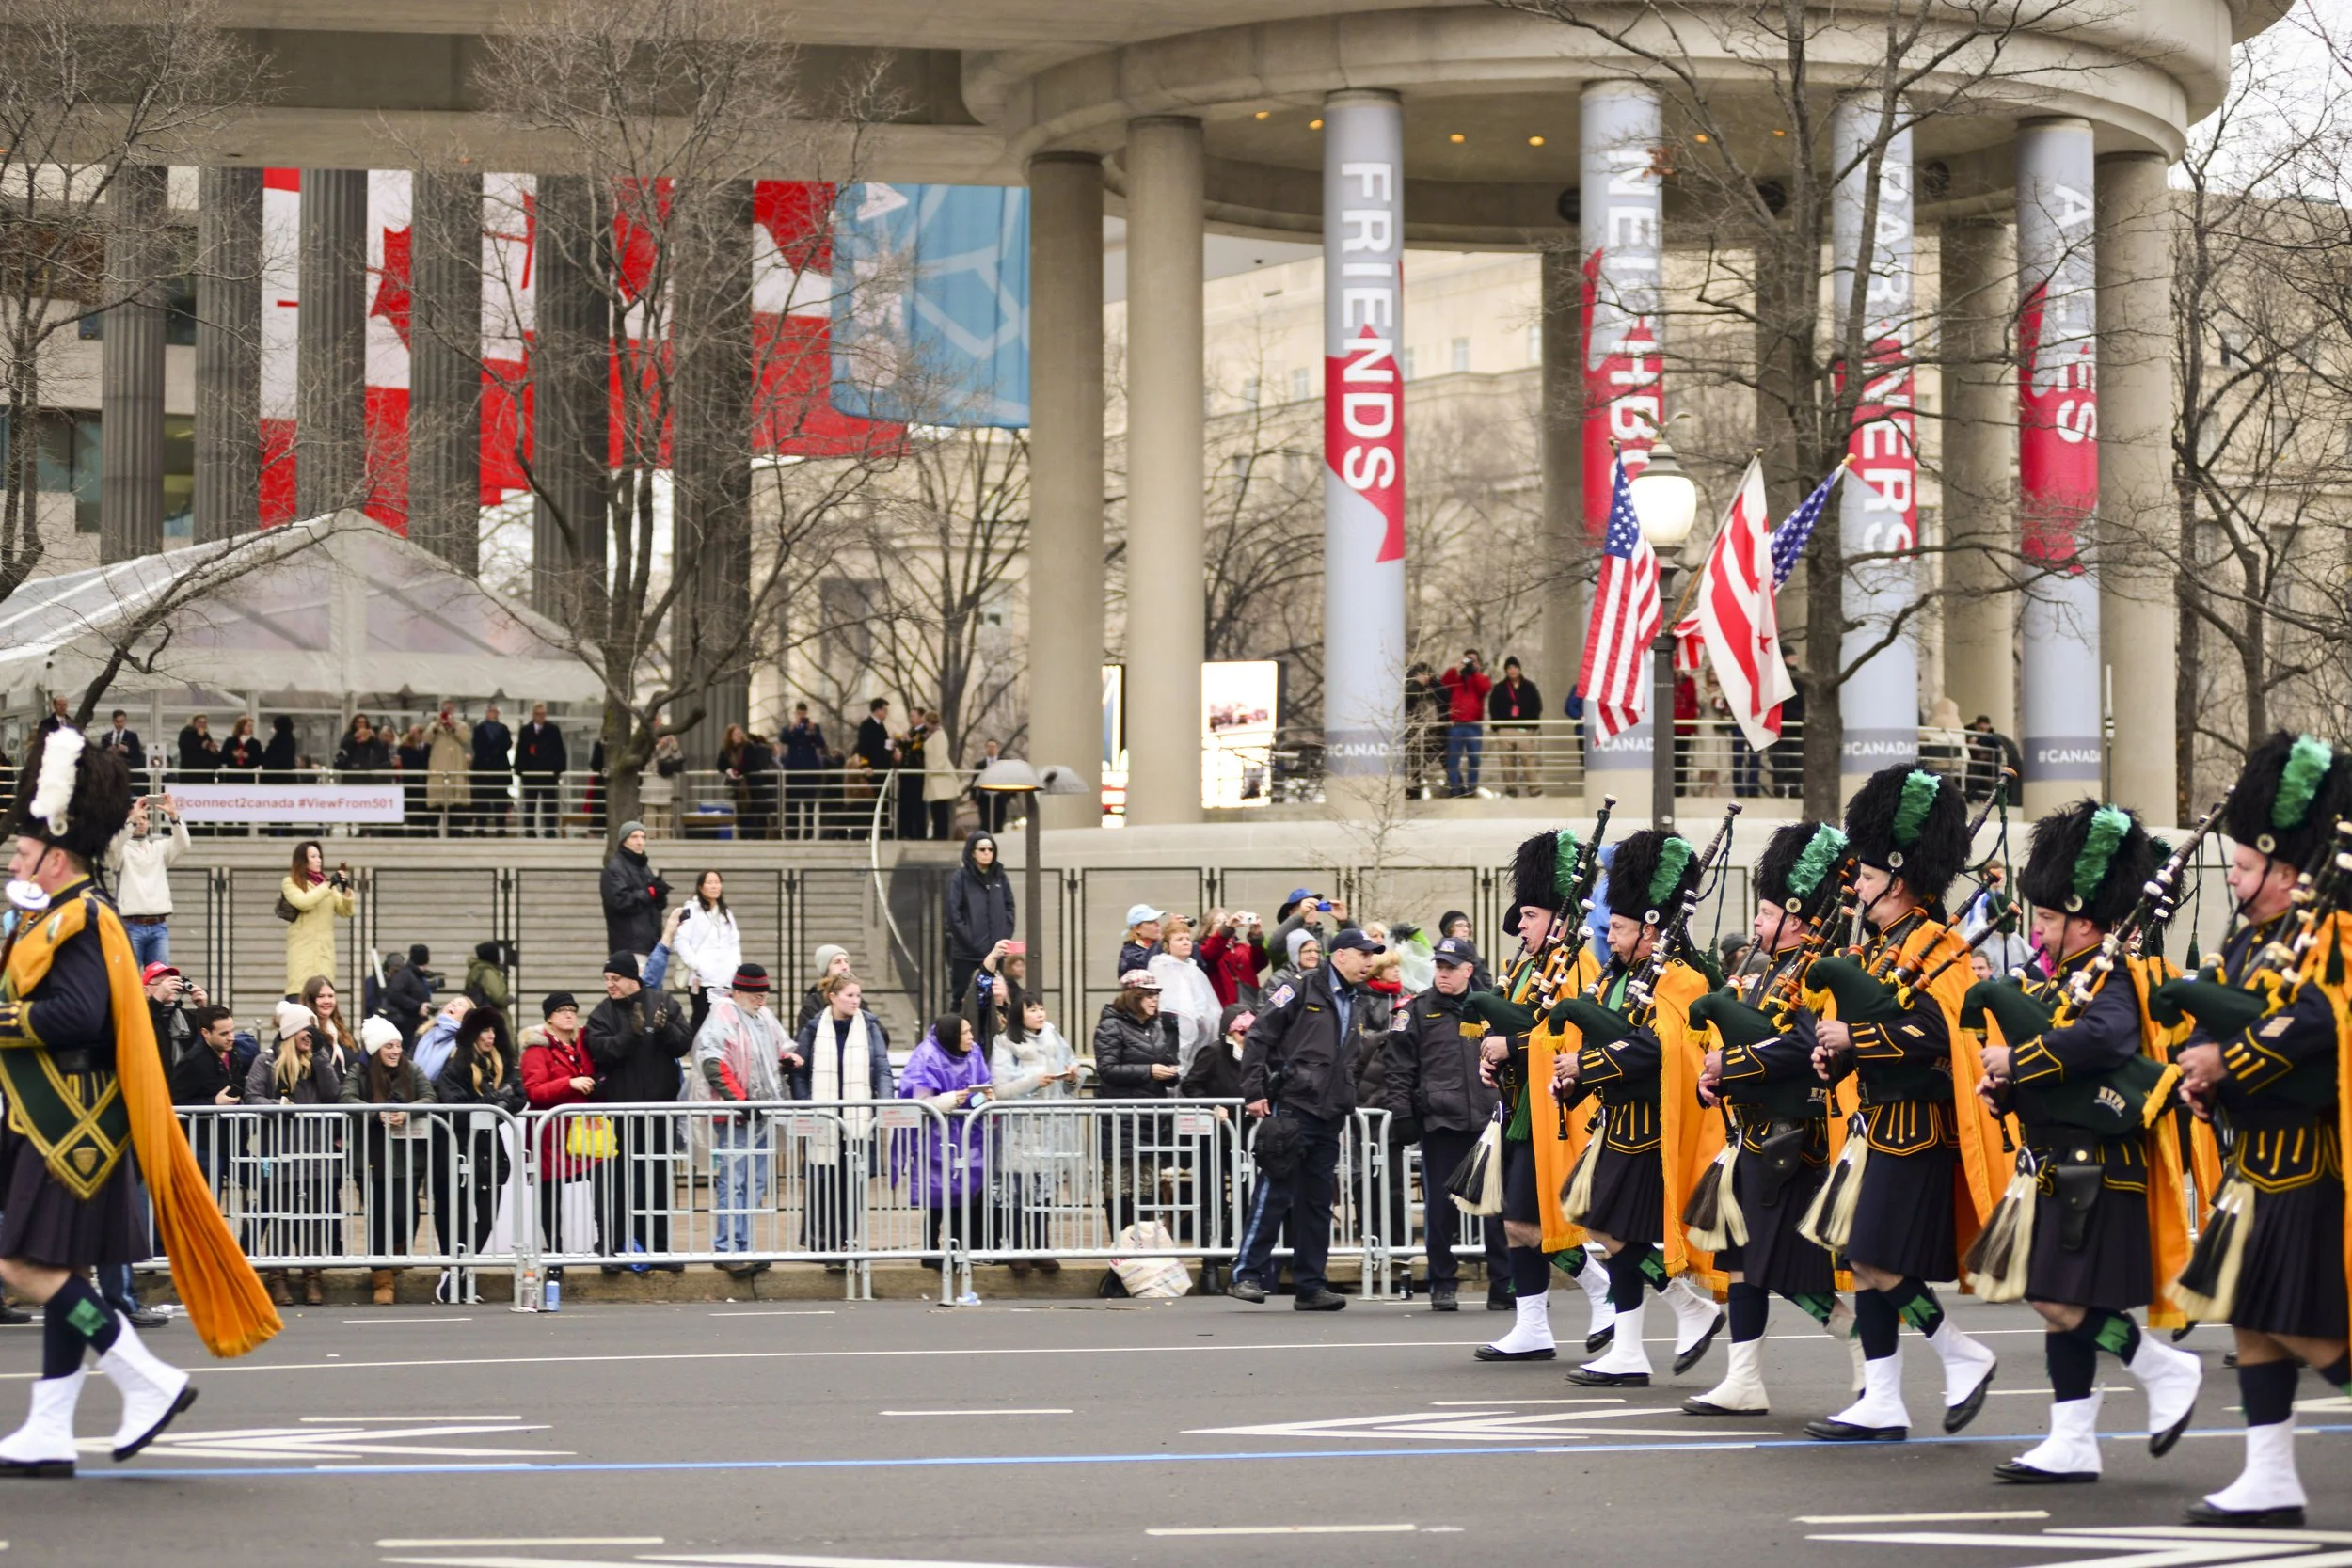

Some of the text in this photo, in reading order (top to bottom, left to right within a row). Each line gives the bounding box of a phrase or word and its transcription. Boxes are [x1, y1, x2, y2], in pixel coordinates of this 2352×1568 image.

[1342, 163, 1396, 490] FRIENDS
[175, 796, 394, 811] @connect2canada #ViewFrom501
[2098, 1085, 2126, 1112] NYPD
